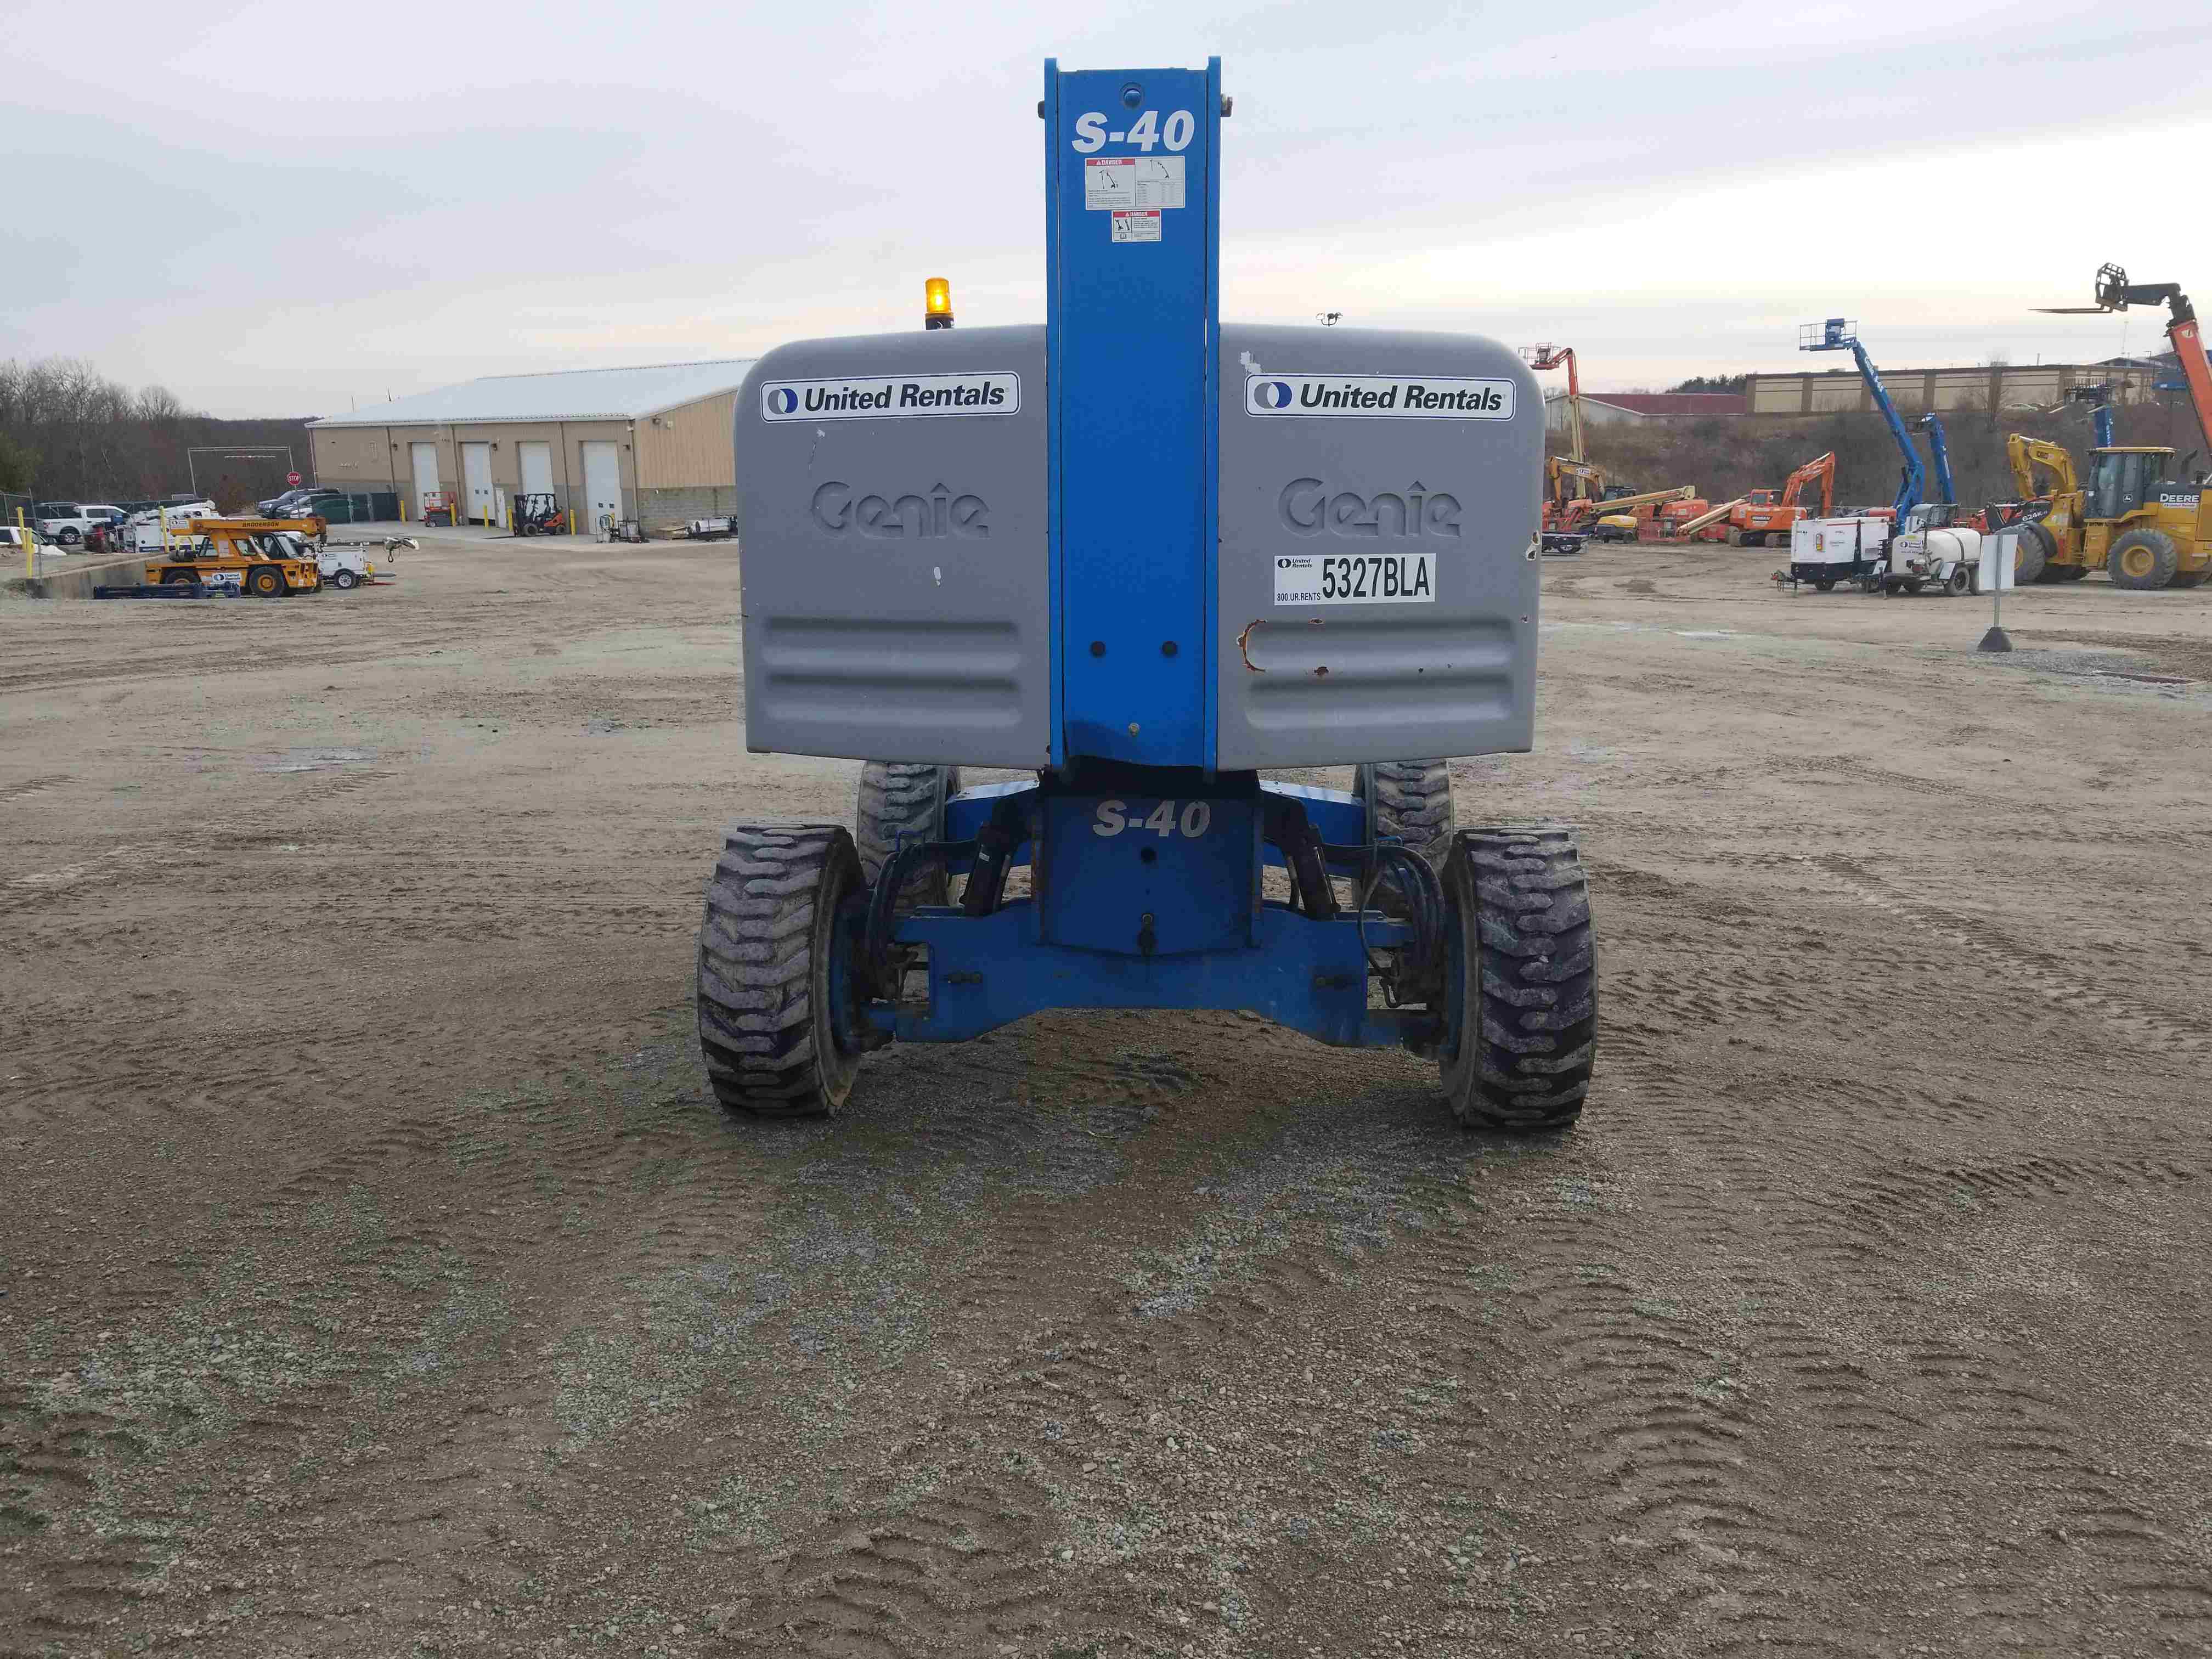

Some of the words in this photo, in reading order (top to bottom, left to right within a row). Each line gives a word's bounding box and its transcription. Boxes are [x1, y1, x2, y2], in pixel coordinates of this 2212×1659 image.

[1071, 110, 1195, 153] S-40
[804, 385, 893, 412] United
[899, 381, 1005, 408] Rentals
[1300, 383, 1398, 409] United
[1404, 385, 1503, 411] Rentals
[811, 481, 990, 539] Genie
[1279, 477, 1462, 538] Genie
[2159, 493, 2199, 503] DEERE
[1277, 592, 1321, 601] 800.UR.RENTS
[1322, 556, 1430, 599] 5327BLA
[1092, 799, 1211, 838] S-40
